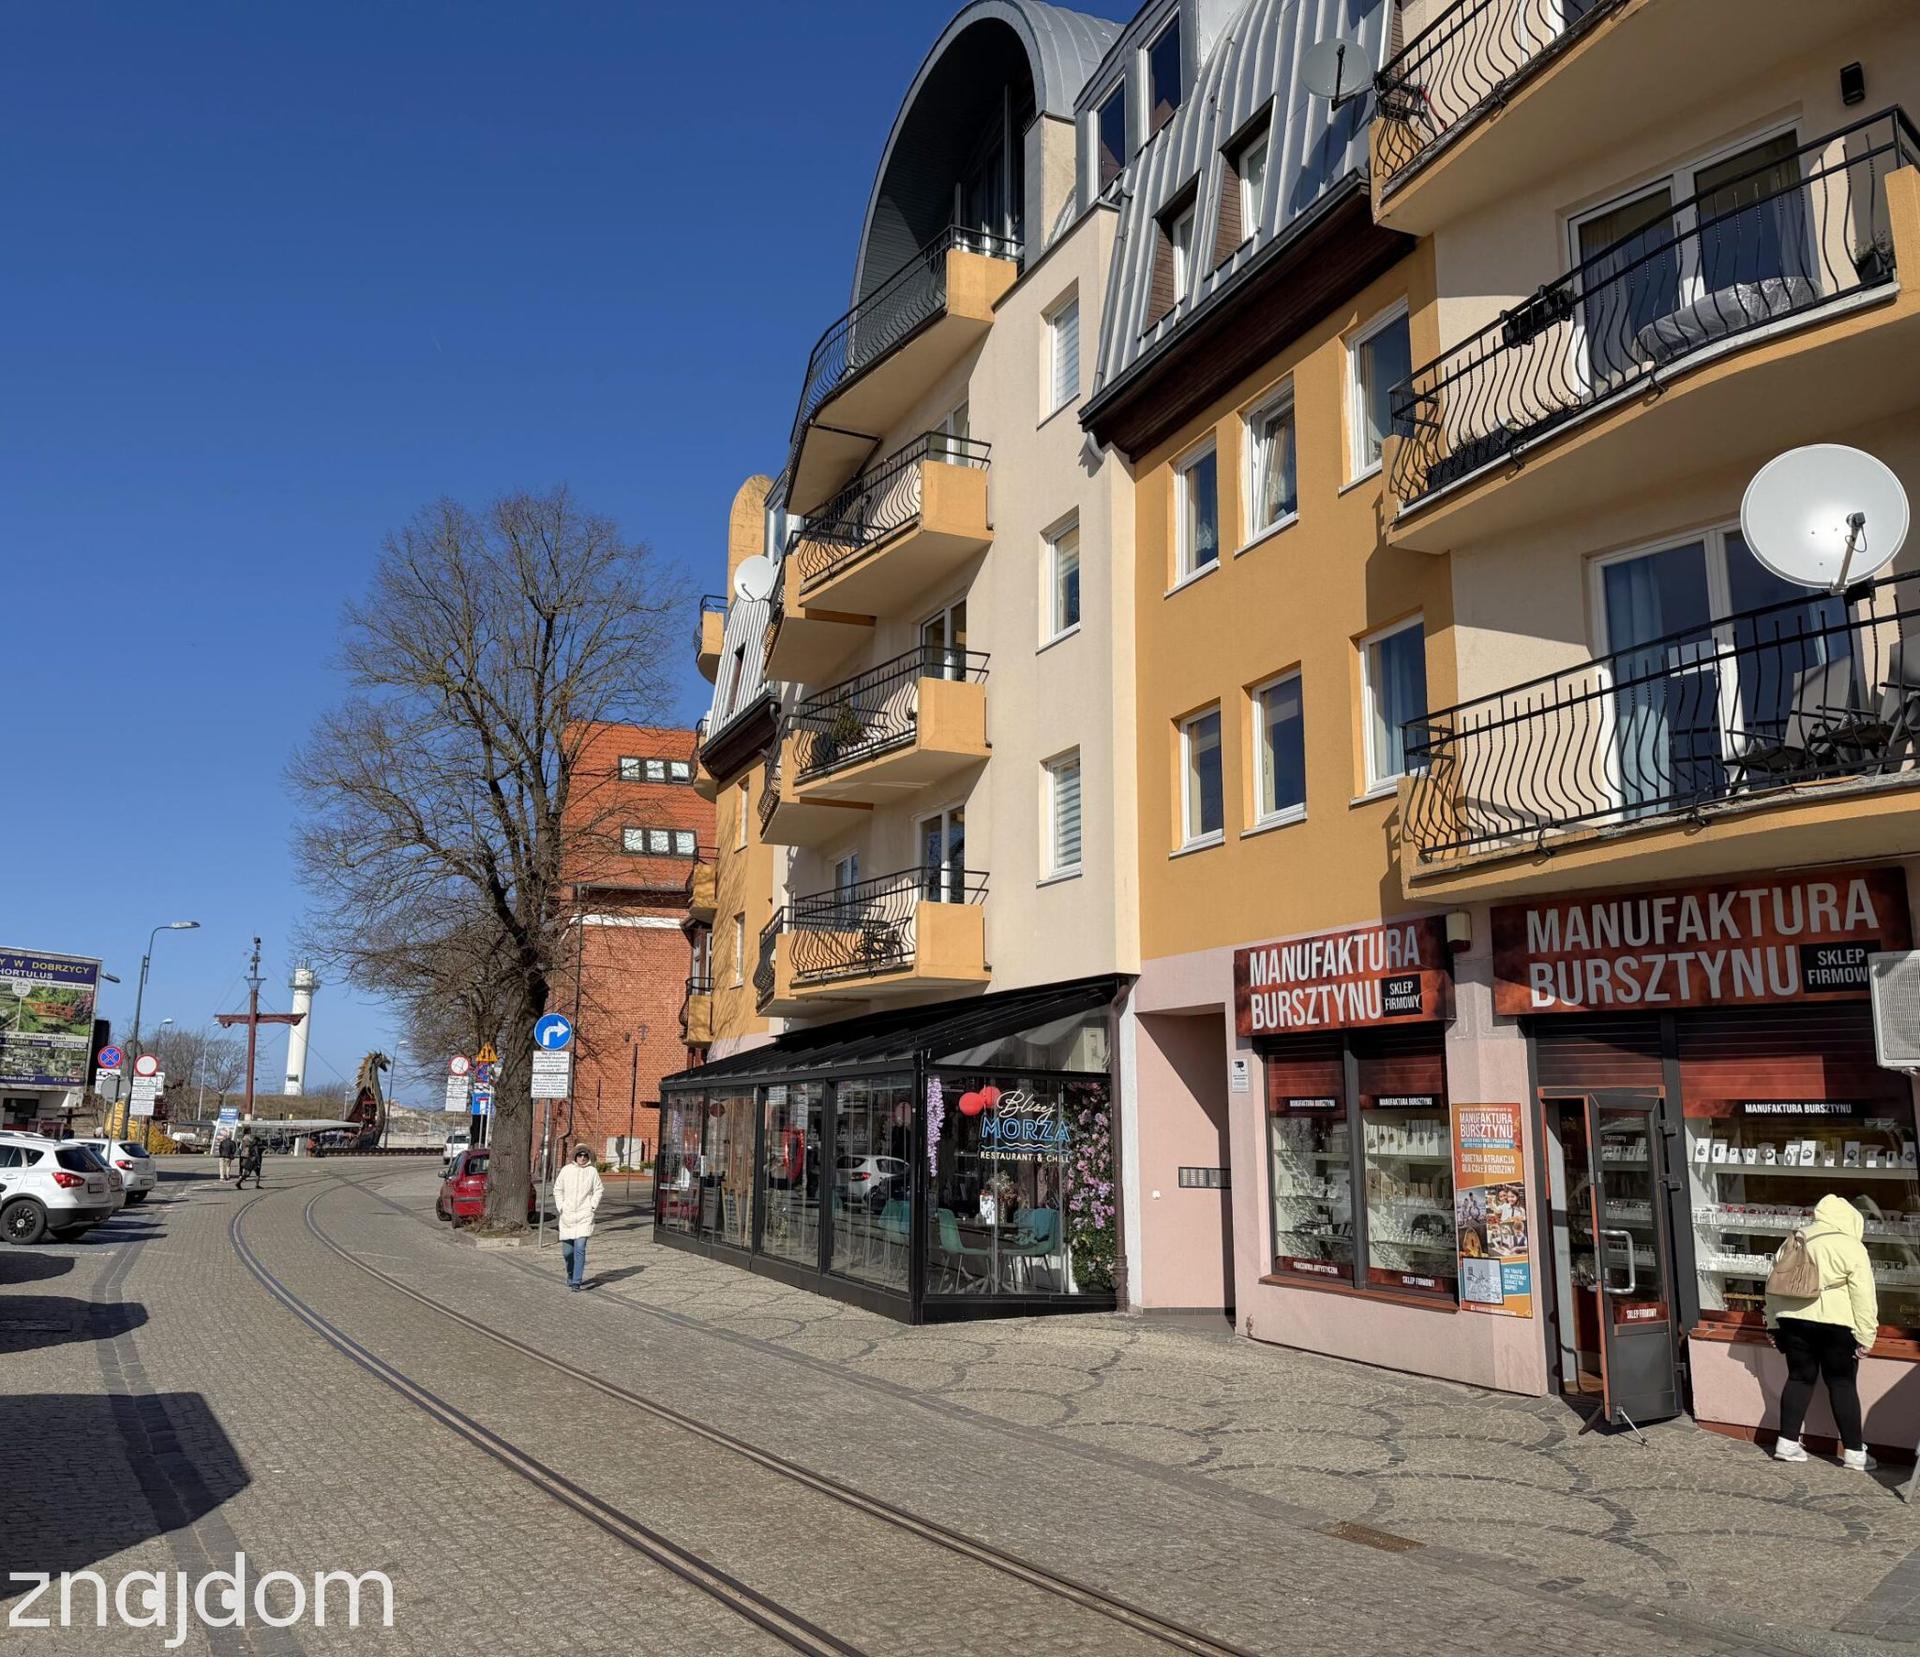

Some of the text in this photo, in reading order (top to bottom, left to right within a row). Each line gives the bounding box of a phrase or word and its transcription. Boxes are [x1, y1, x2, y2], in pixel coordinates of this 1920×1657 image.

[1526, 879, 1879, 954] MANUFAKTURA
[1250, 926, 1421, 987] MANUFAKTURA
[1817, 949, 1865, 966] SKLEP
[32, 961, 89, 974] DOBRZYCY
[1807, 966, 1868, 985] FIRMOW
[1528, 945, 1799, 1008] BURSZTYNU
[1389, 981, 1414, 996] SKLEP
[1251, 979, 1383, 1030] BURSZTYNU
[1385, 995, 1420, 1011] FIRMOWY
[1745, 1103, 1852, 1114] MANUFAKTURA BURSZTYNU
[1460, 1112, 1513, 1124] MANUFAKTURA
[981, 1117, 1071, 1142] MORZA
[1460, 1124, 1513, 1138] BURSZTYNU
[980, 1151, 1033, 1161] RESTAURANT
